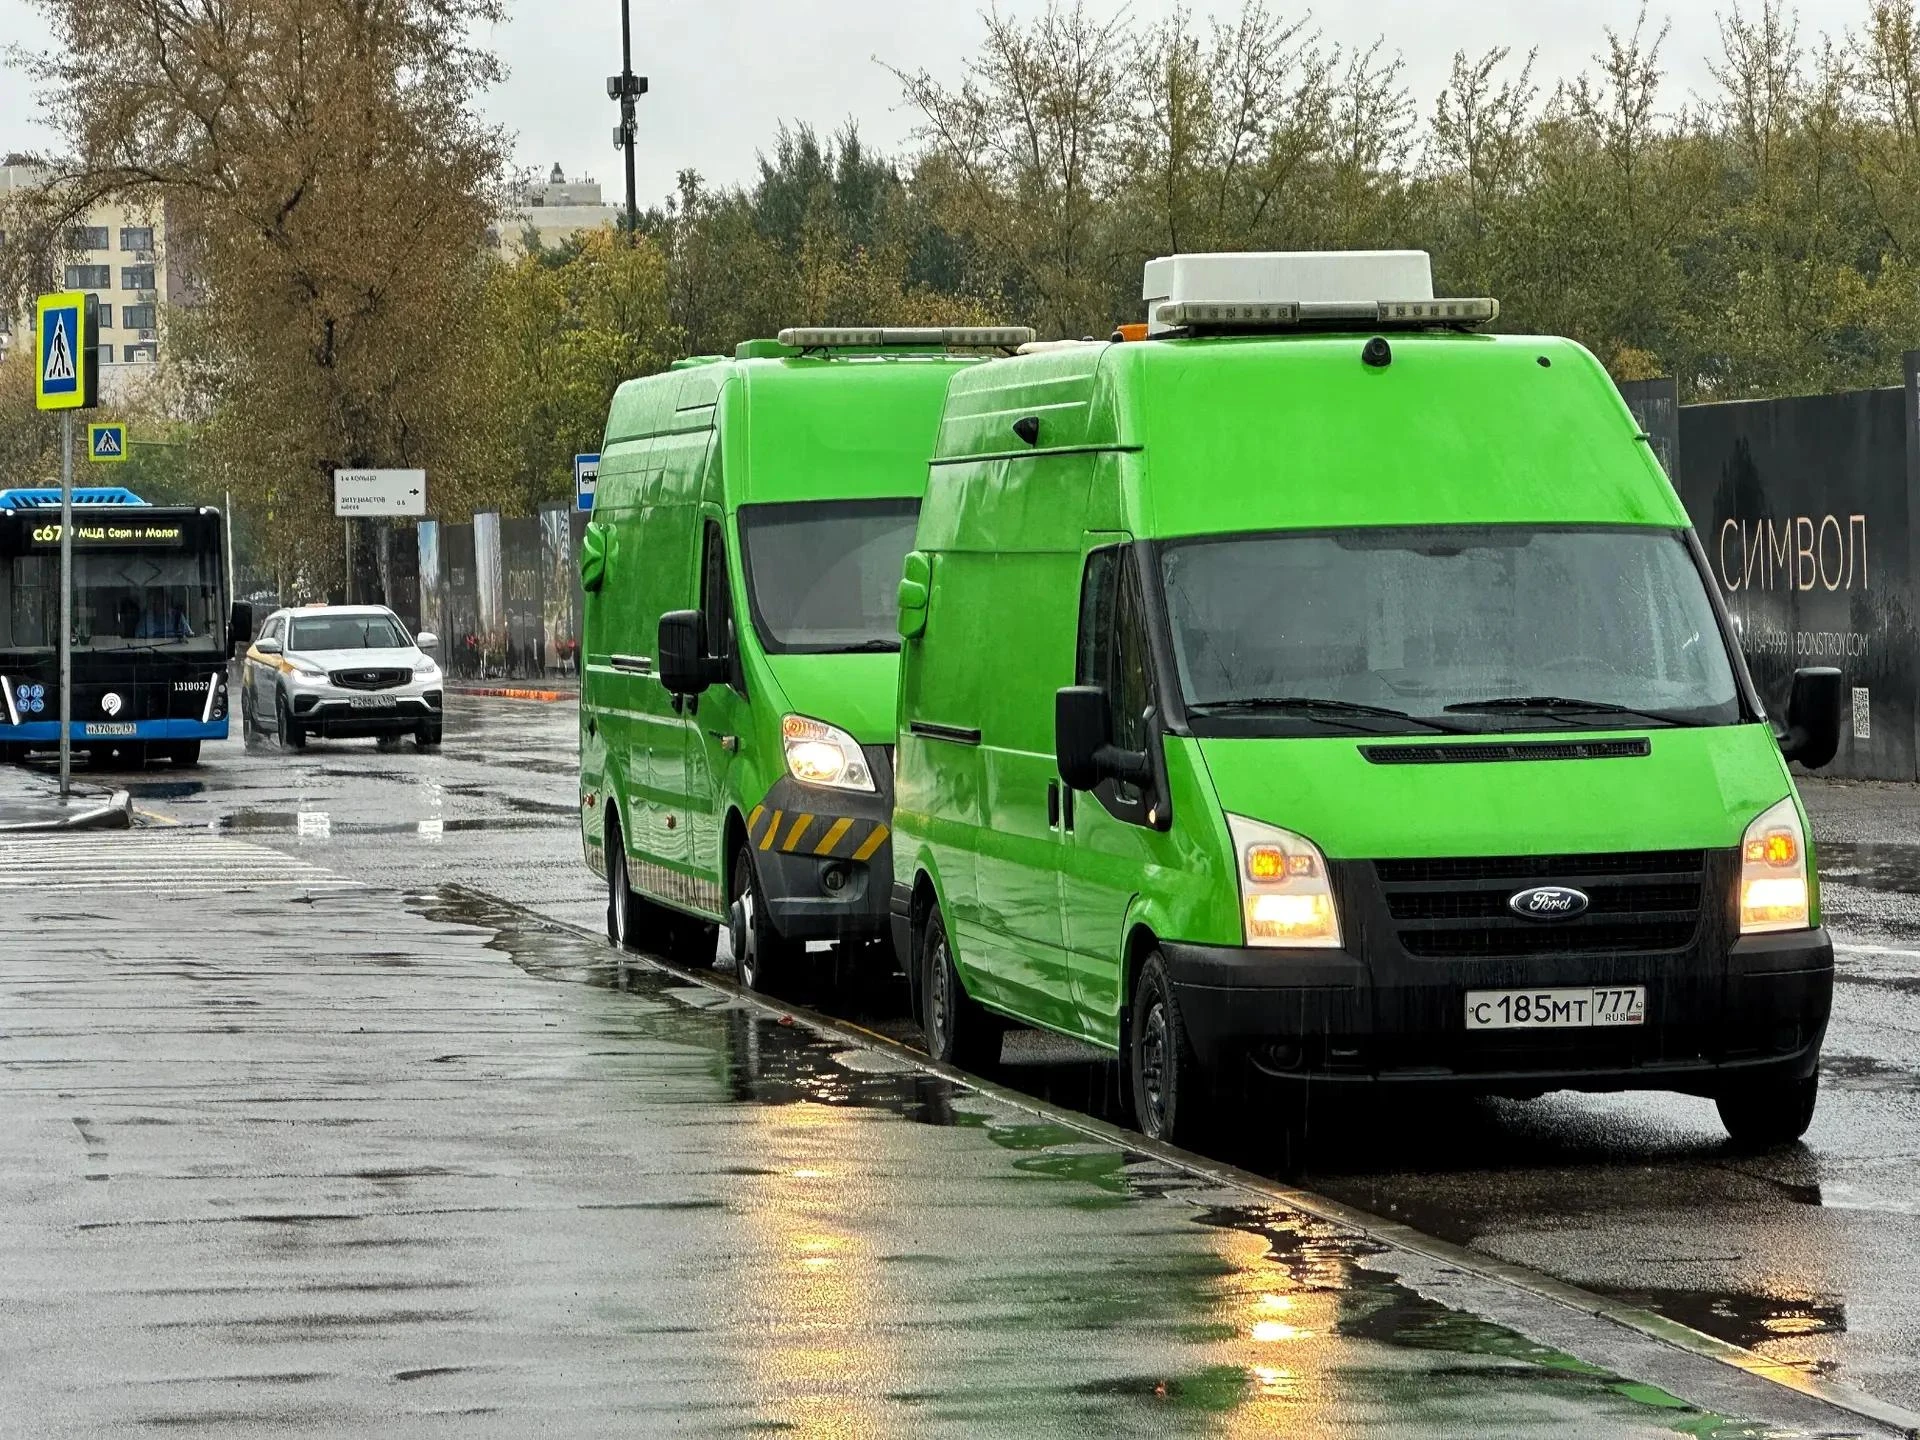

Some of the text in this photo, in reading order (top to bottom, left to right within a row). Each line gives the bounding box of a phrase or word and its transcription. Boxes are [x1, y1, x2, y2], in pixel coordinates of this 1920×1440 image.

[33, 525, 179, 541] с67 МЦД Серп и Молот
[1720, 514, 1868, 592] СИМВОЛ
[1529, 891, 1572, 911] Ford
[1595, 989, 1637, 1014] 777
[1605, 1012, 1626, 1022] RUS
